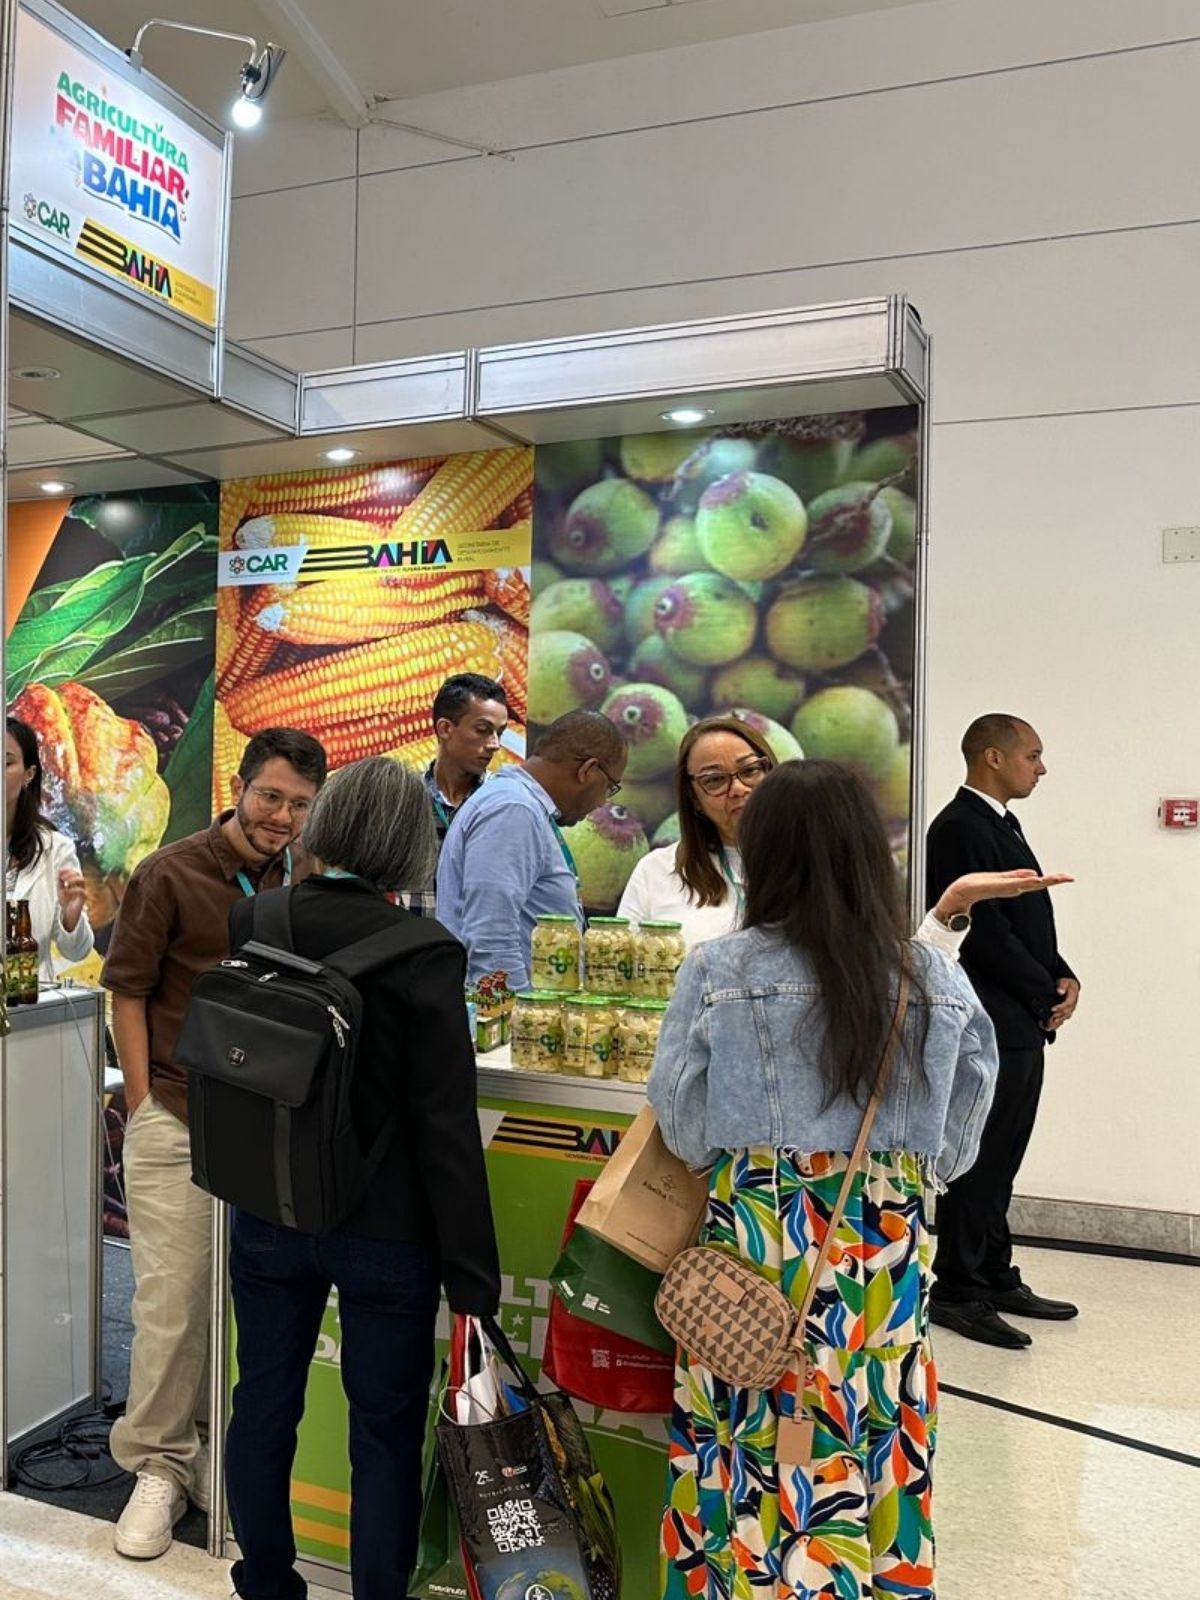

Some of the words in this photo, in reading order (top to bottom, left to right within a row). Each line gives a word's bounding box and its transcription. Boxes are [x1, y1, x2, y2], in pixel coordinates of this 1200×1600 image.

[56, 94, 187, 205] FAMILIAR
[57, 71, 190, 175] AGRICULTURA
[37, 200, 70, 239] CAR
[83, 151, 182, 239] BAHIA
[246, 553, 289, 574] CAR
